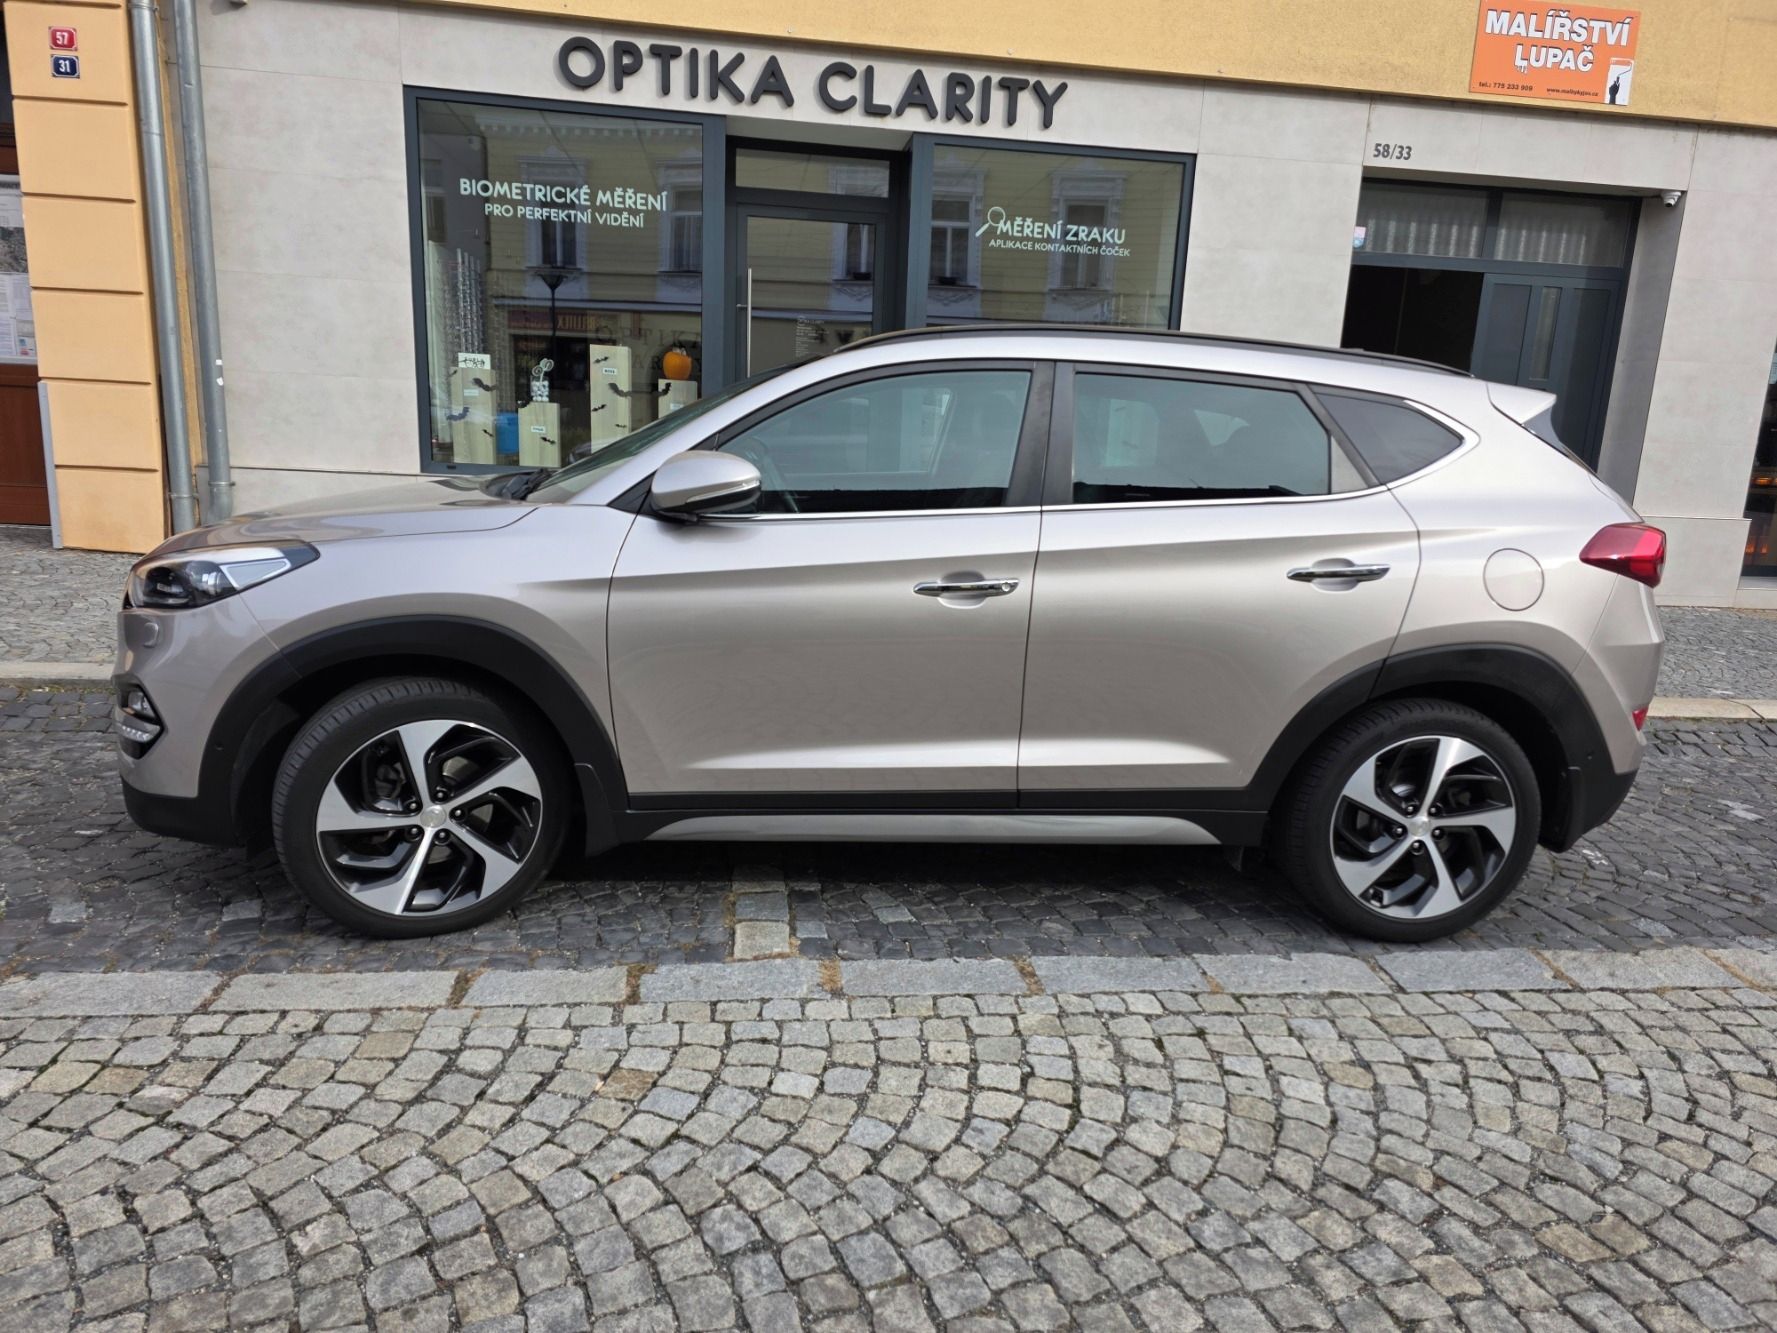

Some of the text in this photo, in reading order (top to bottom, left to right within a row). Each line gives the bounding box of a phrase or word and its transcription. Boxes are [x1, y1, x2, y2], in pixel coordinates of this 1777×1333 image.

[56, 31, 68, 45] 57
[1485, 9, 1633, 46] MALÍŘSTVÍ
[58, 59, 70, 73] 31
[1514, 44, 1595, 73] LUPAČ
[556, 36, 1068, 129] OPTIKA CLARITY
[1373, 143, 1412, 160] 58/33
[459, 178, 668, 212] BIOMETRICKÉ MĚŘENÍ
[484, 203, 645, 228] PRO PERFEKTNÍ VIDĚNÍ
[996, 217, 1126, 244] MĚŘENÍ ZRAKU
[989, 239, 1131, 257] APLIKACE KONTAKTNÍCH ČOČEK
